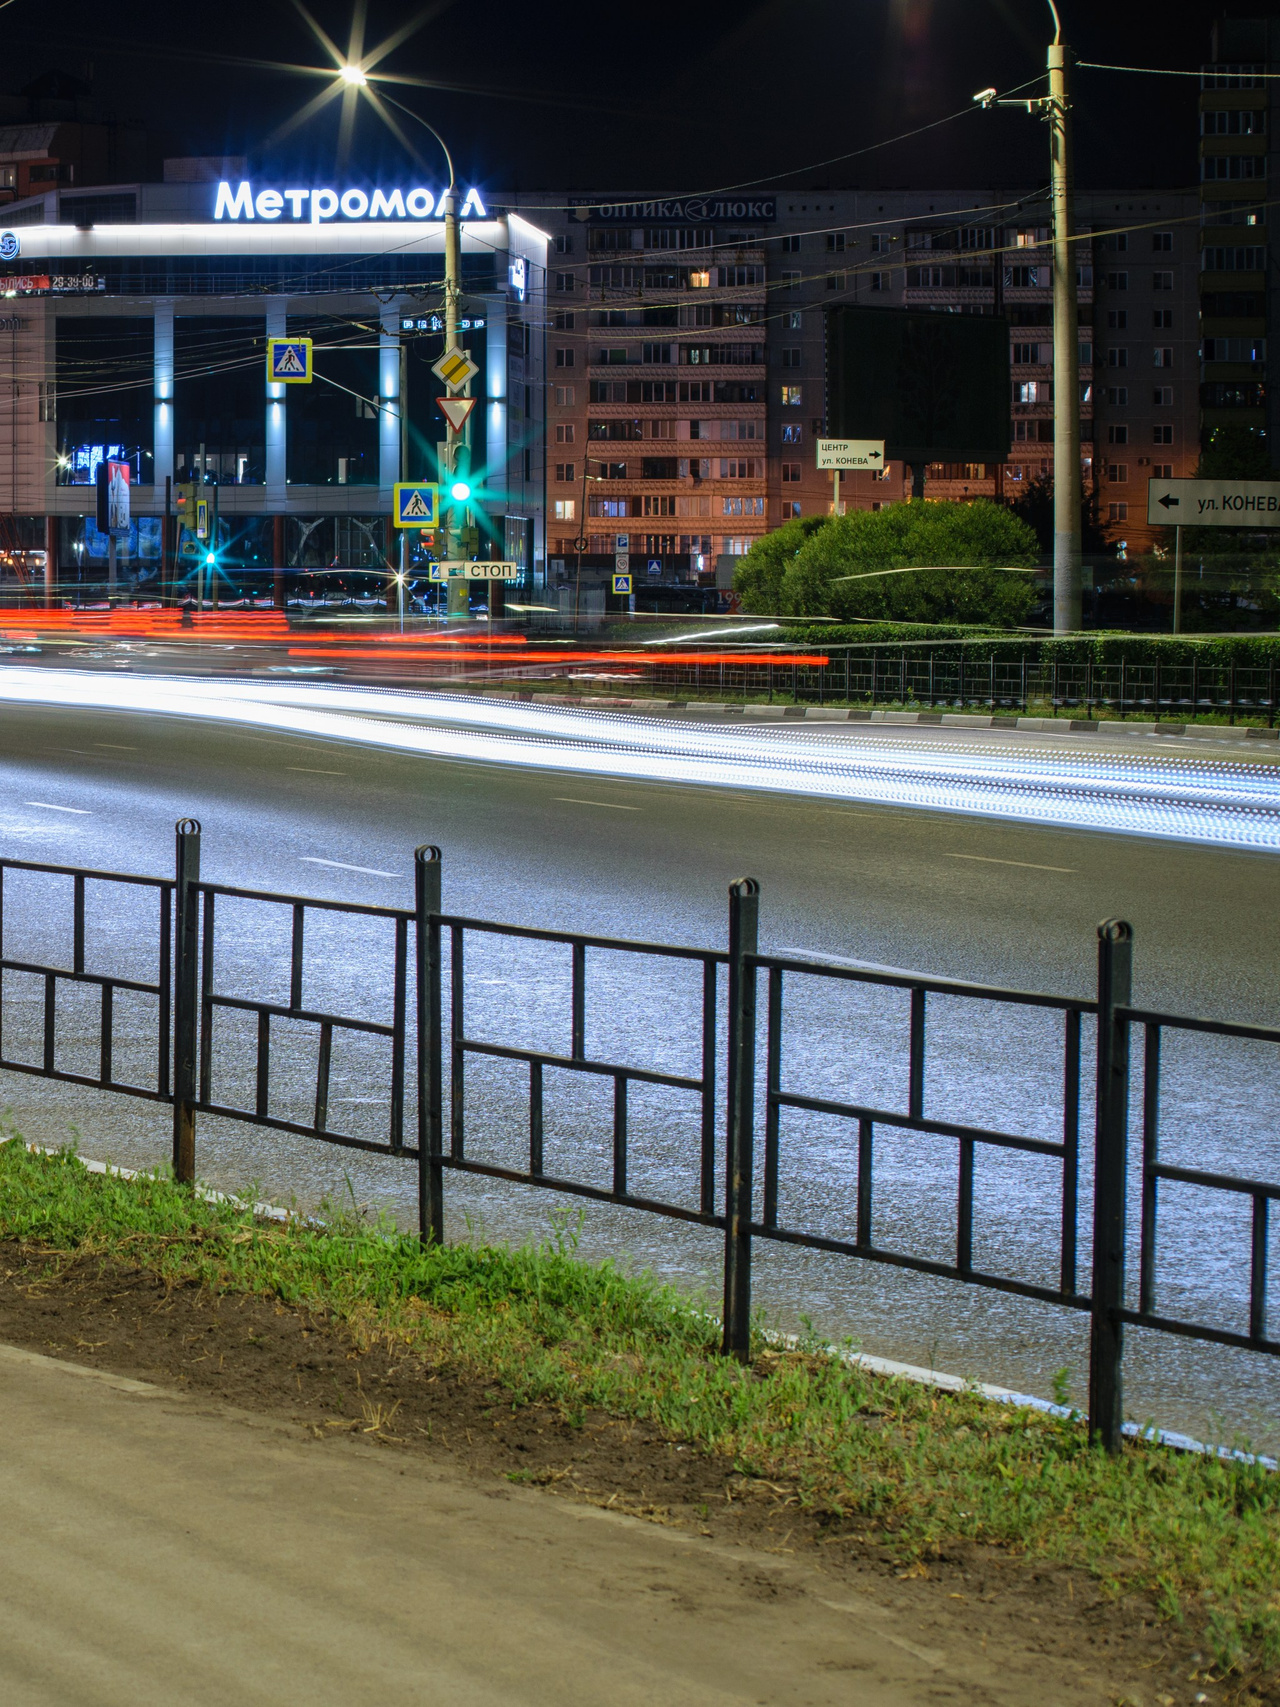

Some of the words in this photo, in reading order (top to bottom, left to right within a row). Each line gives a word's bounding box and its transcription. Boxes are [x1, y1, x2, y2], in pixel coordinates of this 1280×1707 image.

[599, 202, 685, 218] ОПТИКА
[710, 202, 774, 218] ЛЮКС
[52, 276, 94, 288] 29-39-00
[821, 444, 849, 452] ЦЕНТР
[836, 457, 869, 465] КОНЕВА
[1197, 498, 1219, 514] ул.
[1222, 495, 1280, 511] КОНЕВ
[470, 565, 512, 577] СТОП
